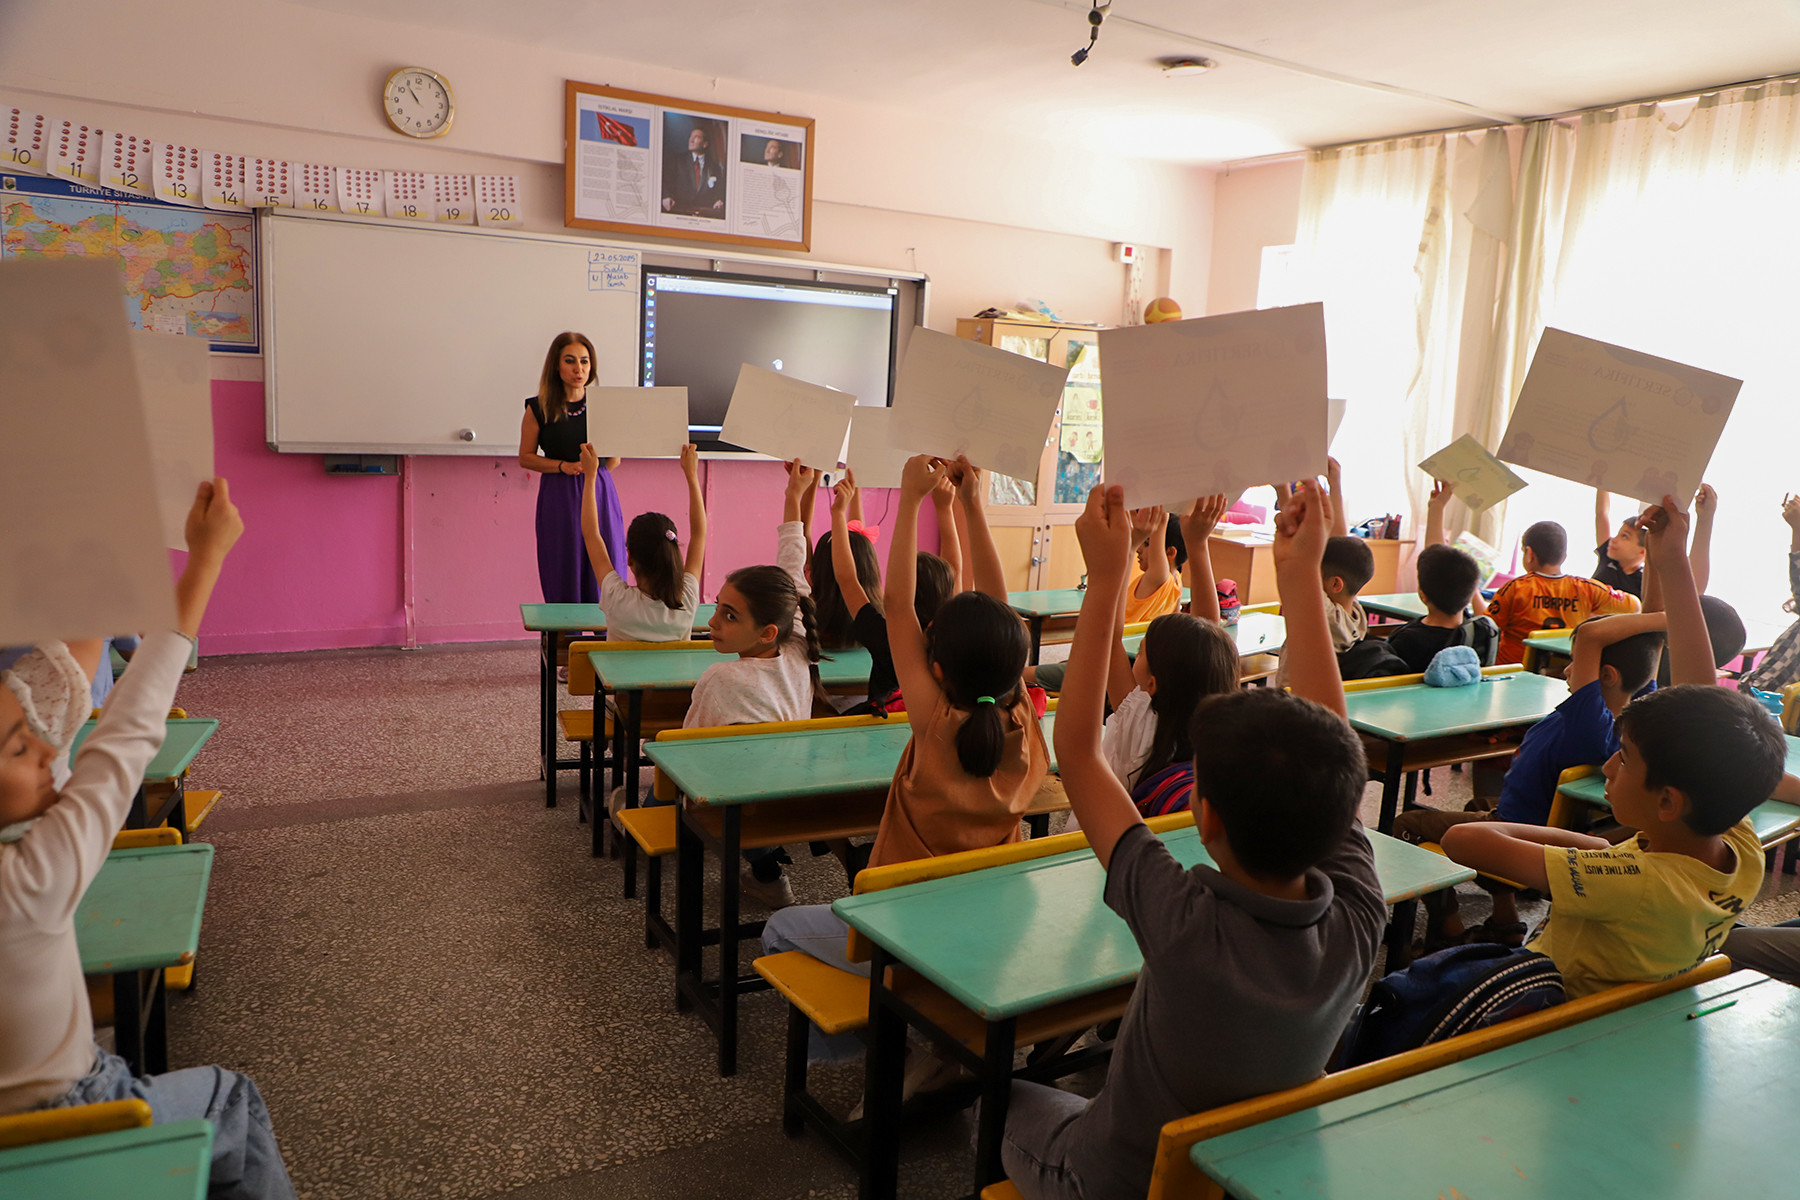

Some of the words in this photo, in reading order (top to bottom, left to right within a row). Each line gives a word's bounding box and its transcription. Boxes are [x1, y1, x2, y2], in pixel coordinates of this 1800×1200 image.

[12, 147, 32, 165] 10
[70, 163, 82, 178] 11
[121, 172, 139, 188] 12
[172, 182, 188, 198] 13
[221, 190, 238, 206] 14
[263, 195, 280, 206] 15
[312, 198, 328, 211] 16
[356, 201, 370, 214] 17
[403, 204, 417, 217] 18
[446, 208, 460, 220] 19
[490, 208, 510, 221] 20
[1533, 595, 1580, 612] MBAPPÉ
[1584, 864, 1604, 875] MUST
[1605, 864, 1624, 875] TIME
